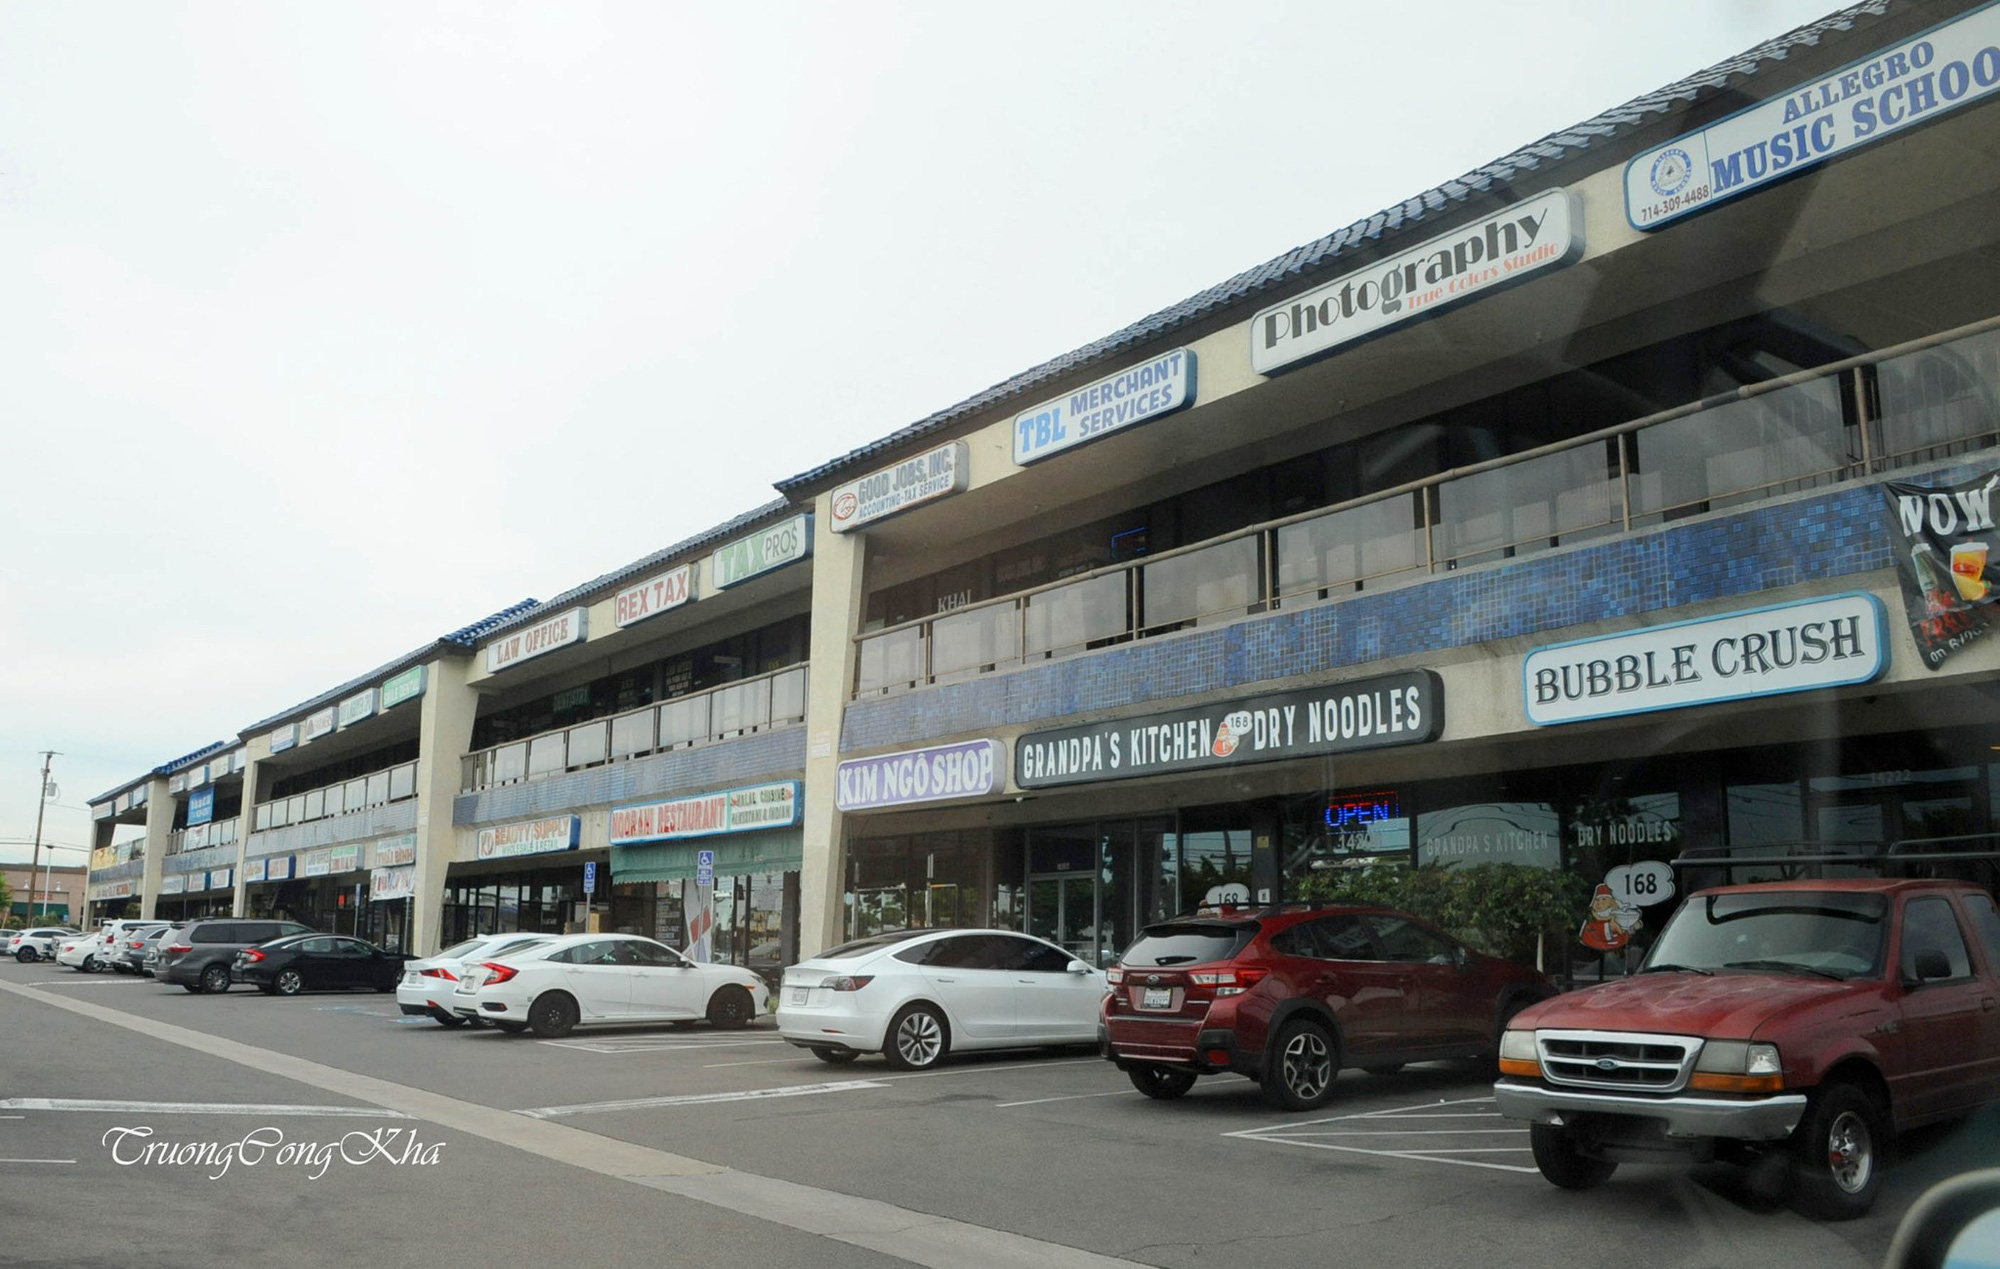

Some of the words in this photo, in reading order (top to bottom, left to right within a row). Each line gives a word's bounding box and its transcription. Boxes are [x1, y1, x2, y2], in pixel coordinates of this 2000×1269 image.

[1783, 41, 1934, 124] ALLEGRO
[1711, 115, 1836, 194] MUSIC
[1641, 184, 1710, 222] 714-309-4488
[1264, 207, 1548, 350] Photography
[1407, 286, 1443, 310] True
[1448, 265, 1499, 293] Colors
[1503, 242, 1560, 272] Studio
[1070, 353, 1182, 417] MERCHANT
[1019, 406, 1067, 454] TBL
[1079, 383, 1173, 438] SERVICES
[858, 472, 890, 505] GOOD
[929, 448, 953, 478] INC.
[919, 474, 949, 497] SERVICE
[617, 587, 649, 624] REX
[653, 570, 688, 608] TAX
[497, 637, 520, 664] LAW
[525, 617, 569, 654] OFFICE
[1535, 644, 1702, 706] BUBBLE
[1710, 615, 1865, 678] CRUSH
[1023, 732, 1121, 780] GRANDPA'S
[1130, 718, 1211, 767] KITCHEN
[1254, 704, 1296, 751] DRY
[1308, 686, 1421, 744] NOODLES
[1230, 715, 1249, 728] 168
[760, 787, 786, 803] CUISINE
[839, 763, 878, 806] KIM
[882, 752, 929, 800] NGÔ
[931, 747, 994, 795] SHOP
[495, 824, 531, 846] BEAUTY
[533, 816, 570, 840] SUPPLY
[612, 807, 655, 839] NOORANI
[657, 797, 725, 834] RESTAURANT
[769, 804, 791, 821] INDIAN
[1324, 799, 1390, 827] OPEN
[1577, 825, 1603, 847] DRY
[1609, 820, 1672, 844] NOODLES
[1426, 833, 1491, 857] GRANDPAS
[1496, 830, 1548, 852] KITCHEN
[1217, 892, 1239, 904] 168
[1625, 872, 1657, 895] 168
